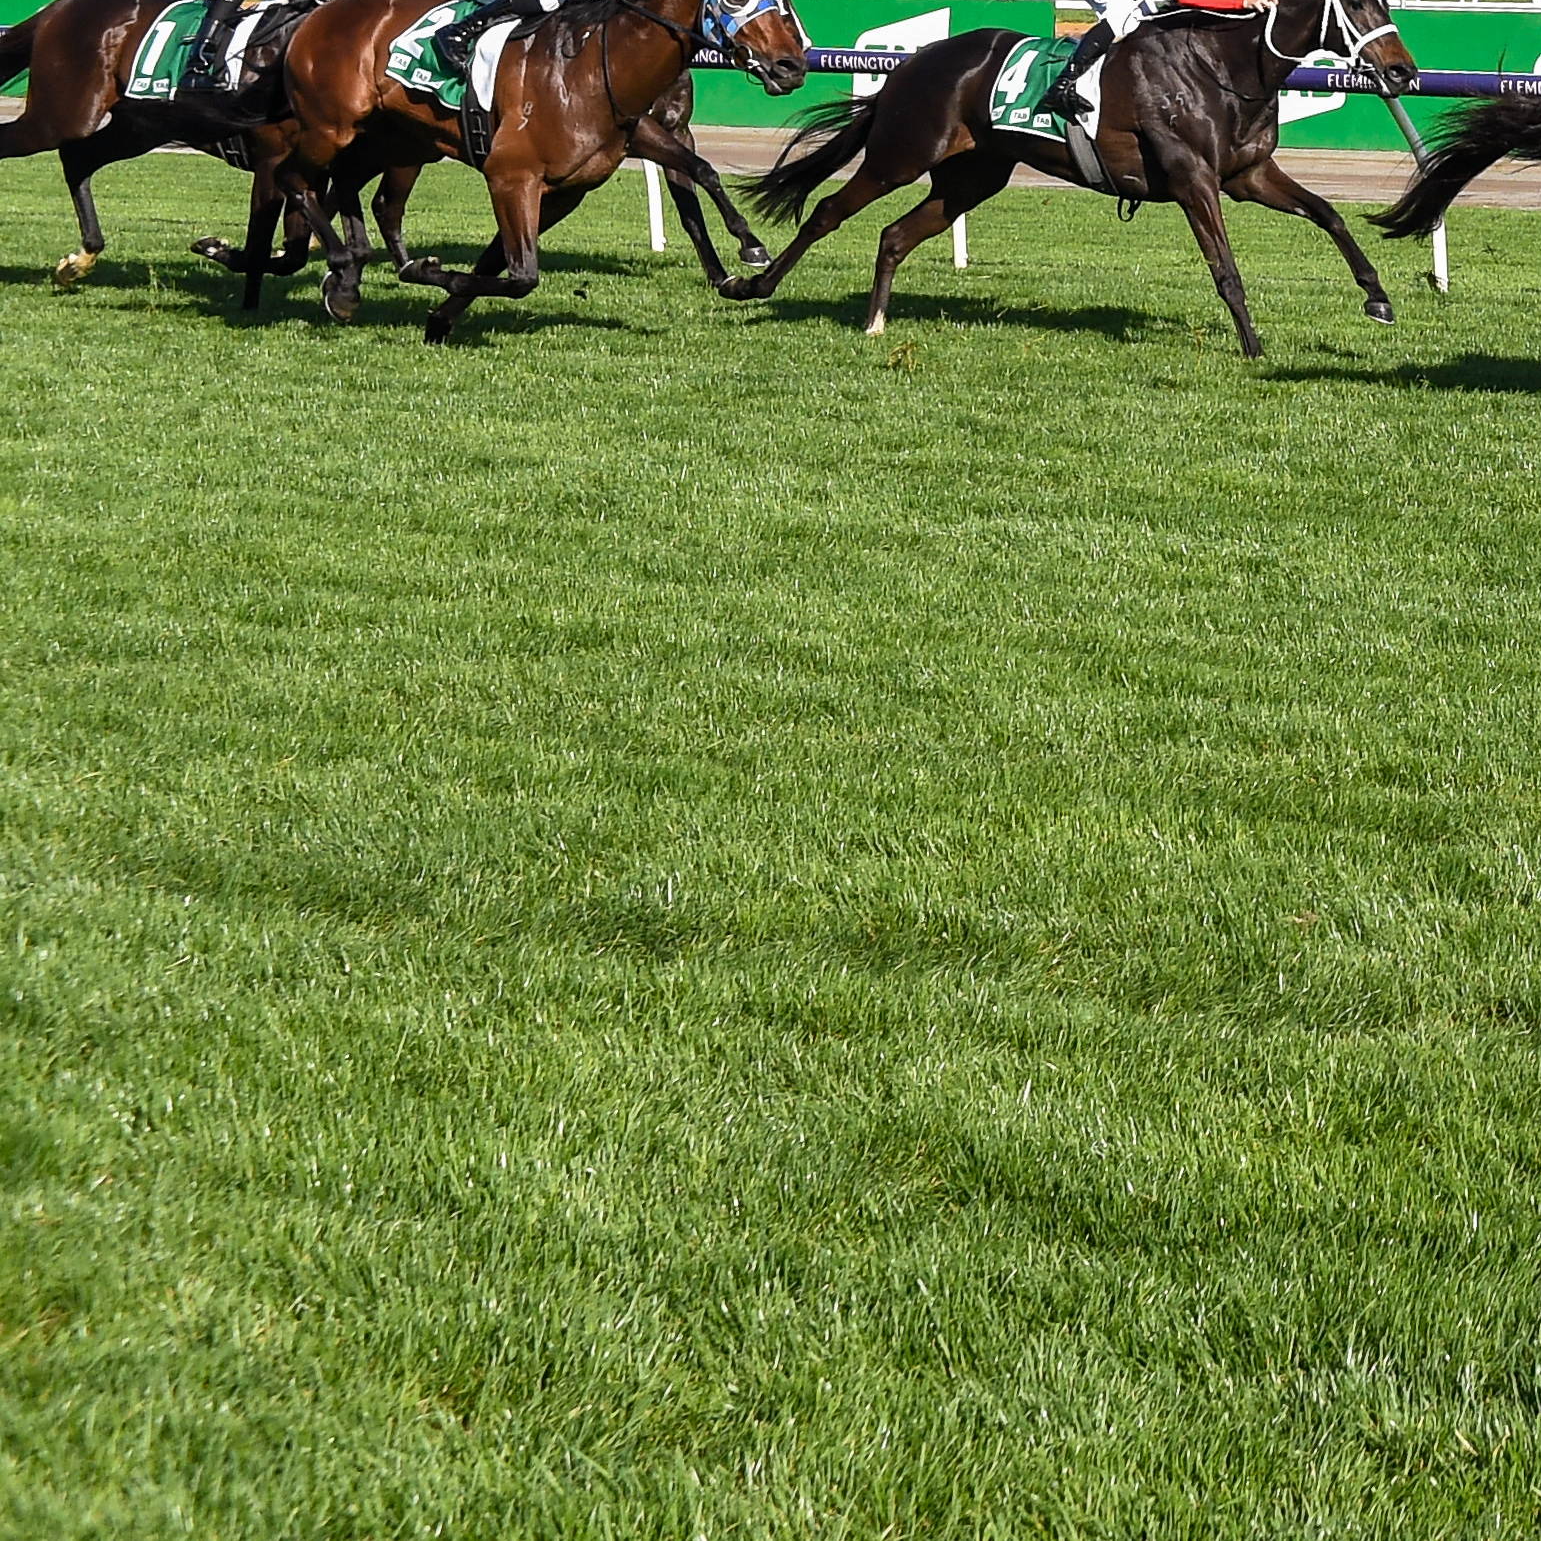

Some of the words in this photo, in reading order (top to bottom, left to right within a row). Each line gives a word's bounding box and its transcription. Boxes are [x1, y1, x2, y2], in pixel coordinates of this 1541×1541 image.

[141, 20, 177, 75] 1
[396, 7, 456, 60] 2
[998, 49, 1039, 104] 4
